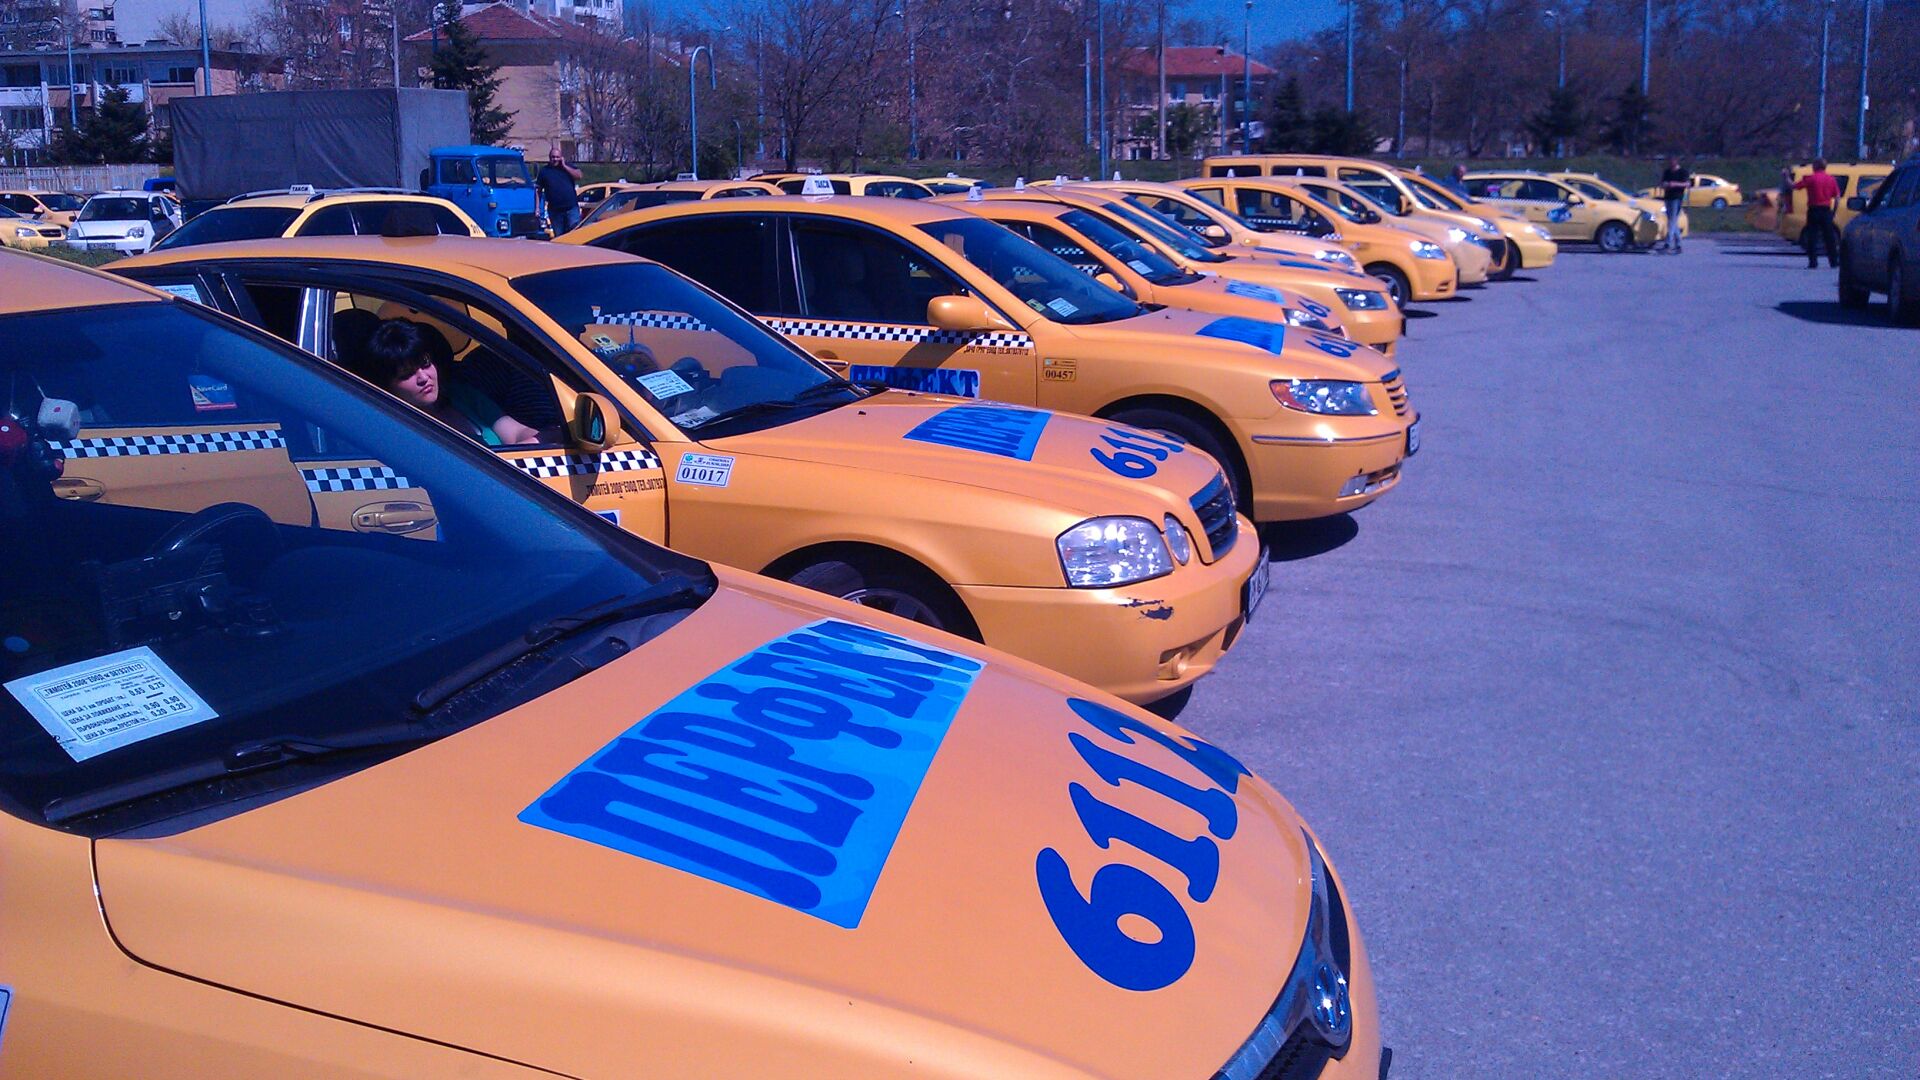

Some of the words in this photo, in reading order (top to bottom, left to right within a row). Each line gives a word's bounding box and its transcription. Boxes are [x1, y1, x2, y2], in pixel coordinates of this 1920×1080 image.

[1045, 369, 1073, 379] 00457
[1089, 427, 1186, 479] 611
[681, 466, 725, 483] 01017
[61, 709, 77, 717] ЦЕНА
[95, 697, 115, 706] ПРОБЕГ
[128, 688, 146, 697] 0.65
[148, 682, 165, 690] 0.75
[68, 716, 84, 724] ЦЕНА
[91, 704, 122, 717] ПОВИКВАНЕ
[77, 716, 117, 732] ПЪРВОНАЧАЛНА
[115, 711, 133, 720] ТАКСА
[143, 701, 160, 710] 0.90
[163, 695, 180, 704] 0.90
[84, 732, 99, 740] ЦЕНА
[150, 708, 167, 717] 0.20
[170, 701, 186, 711] 0.20
[539, 620, 980, 909] ПЕРФЕКТ
[1036, 697, 1253, 991] 6112
